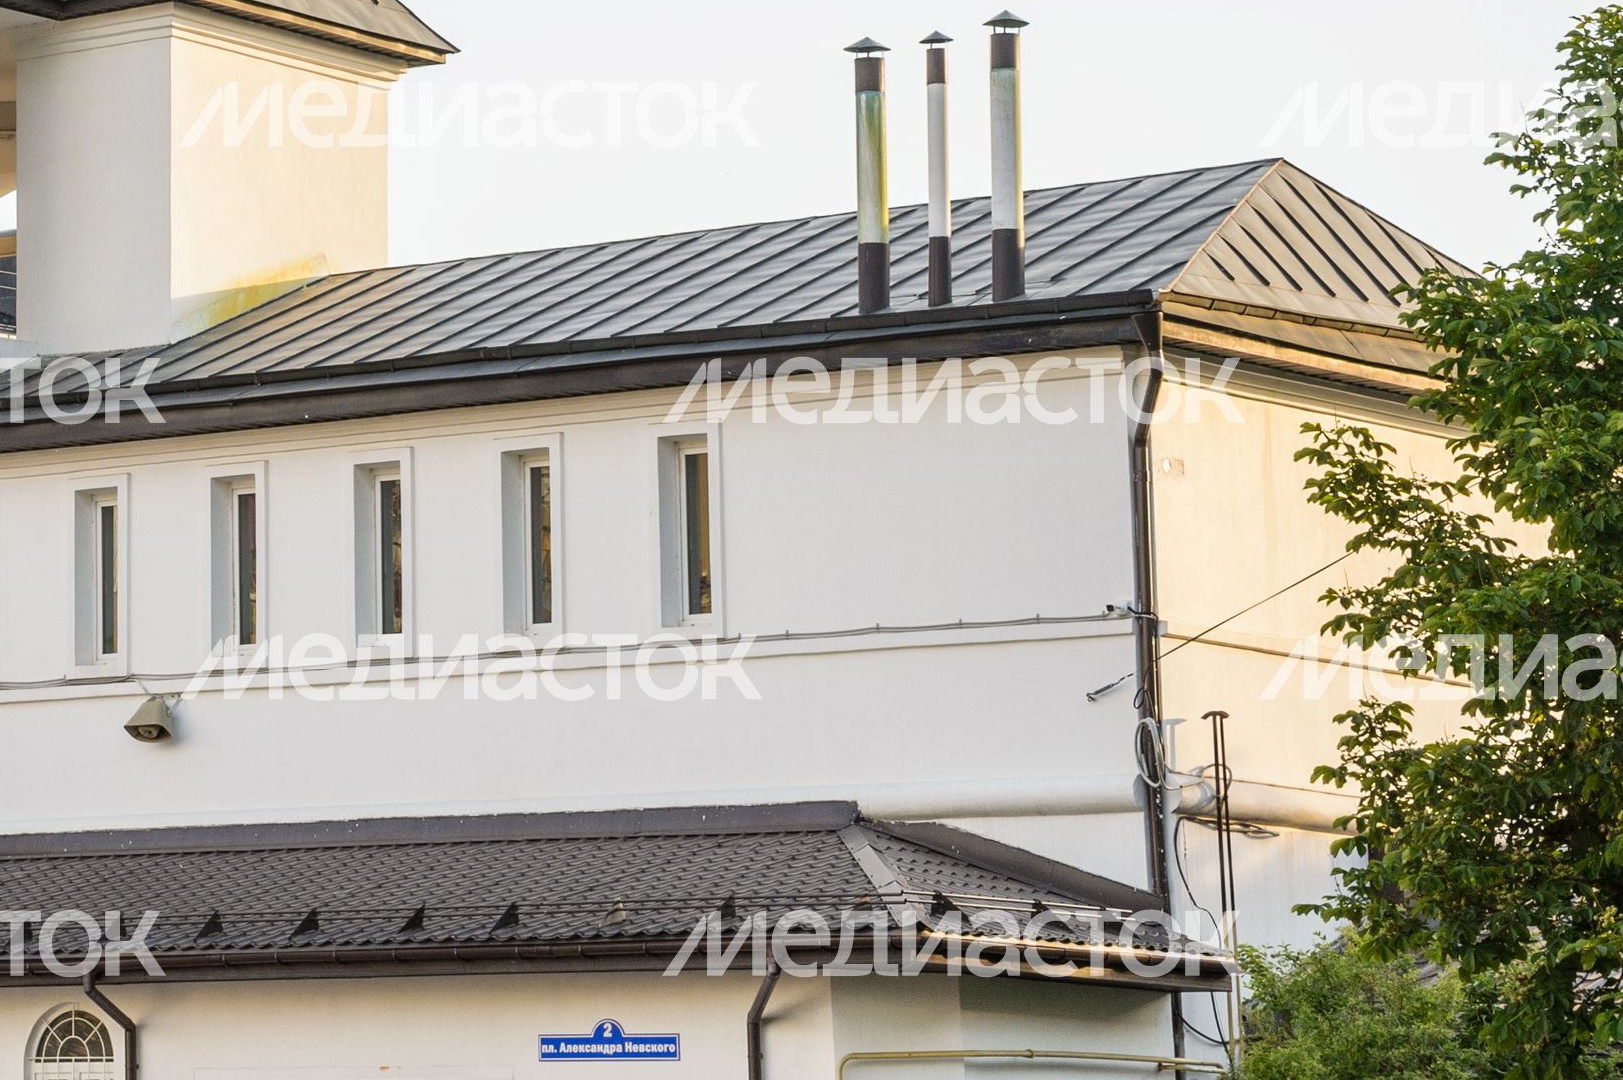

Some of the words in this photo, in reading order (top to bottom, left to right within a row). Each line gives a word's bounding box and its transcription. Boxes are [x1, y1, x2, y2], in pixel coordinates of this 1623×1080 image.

[603, 1023, 612, 1037] 2
[542, 1044, 557, 1053] пл.
[560, 1042, 622, 1055] Александра
[625, 1041, 676, 1053] Невского
